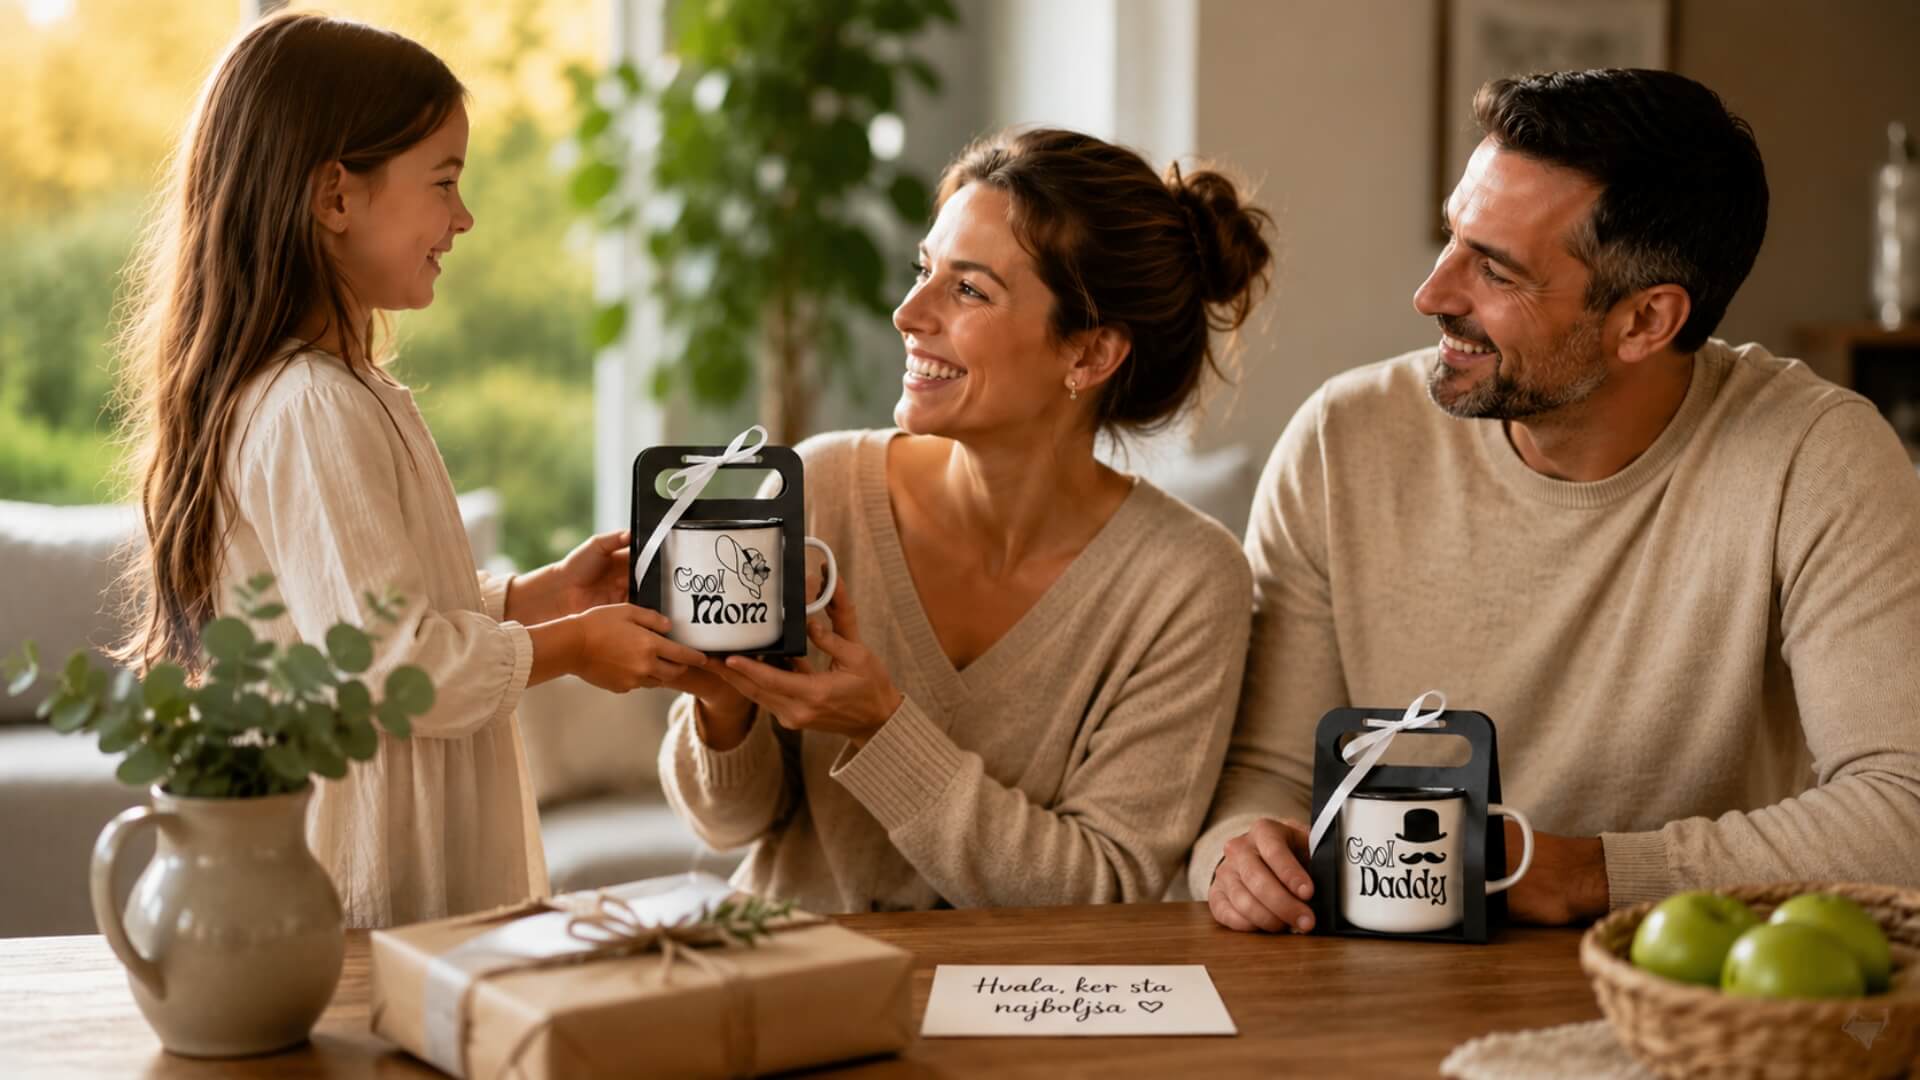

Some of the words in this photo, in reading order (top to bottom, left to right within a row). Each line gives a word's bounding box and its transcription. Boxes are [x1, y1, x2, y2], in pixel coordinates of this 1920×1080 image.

[674, 566, 726, 594] Cool
[690, 594, 768, 625] Mom
[1346, 836, 1395, 867] Cool
[1359, 865, 1447, 906] Daddy
[1075, 976, 1119, 993] ker
[1130, 978, 1173, 993] sta
